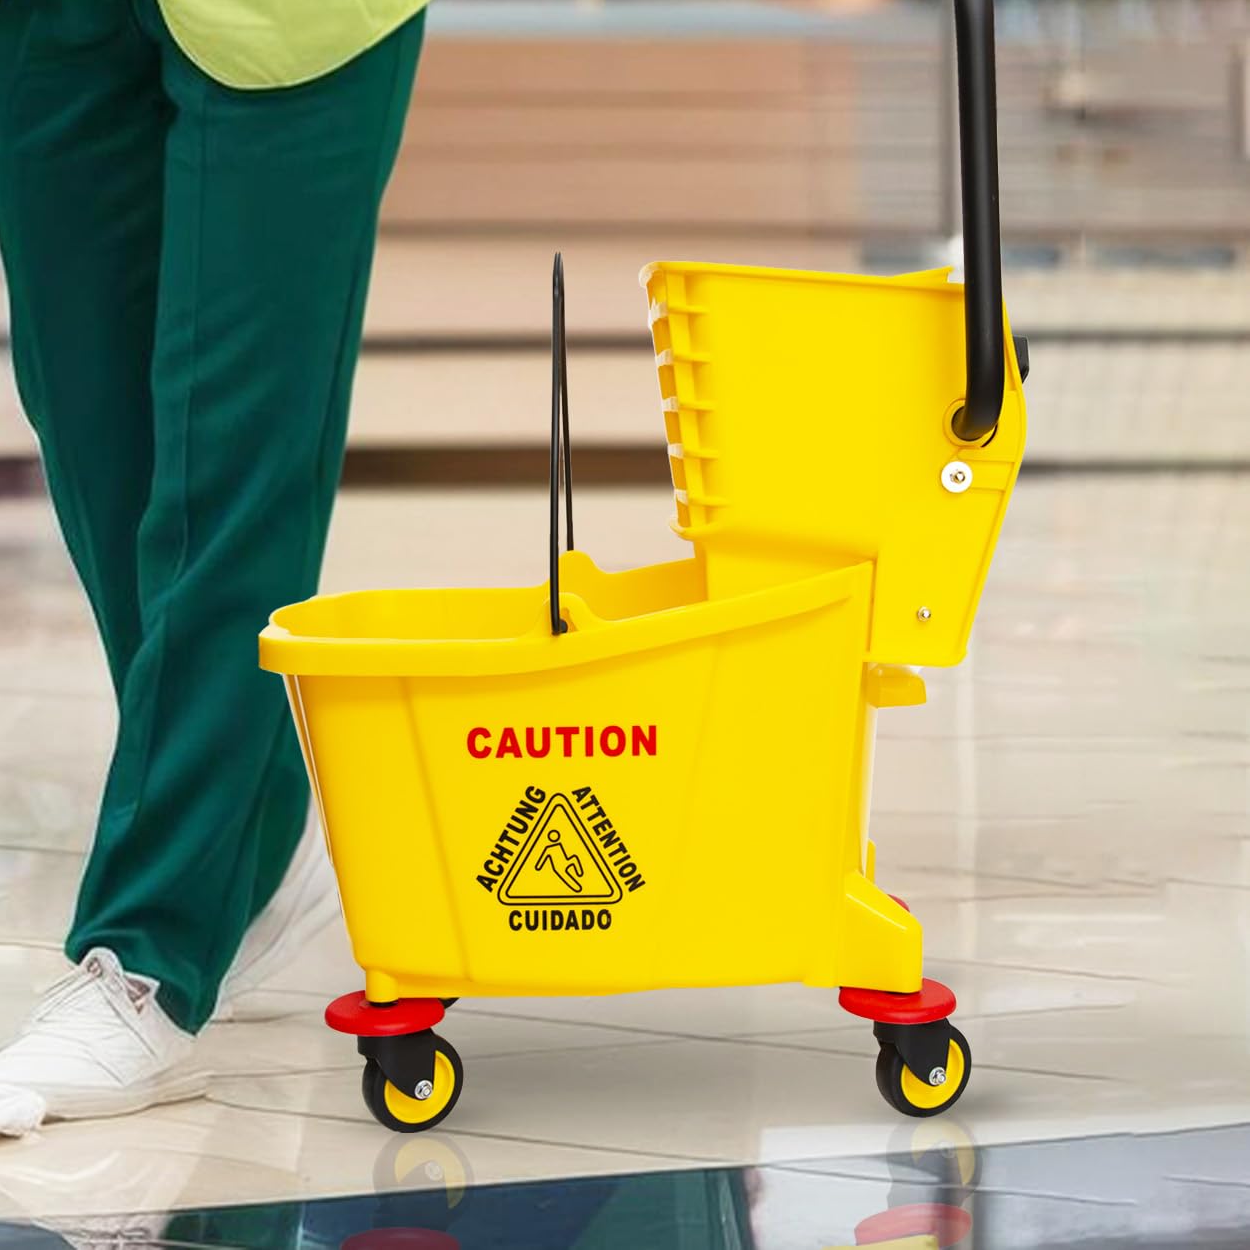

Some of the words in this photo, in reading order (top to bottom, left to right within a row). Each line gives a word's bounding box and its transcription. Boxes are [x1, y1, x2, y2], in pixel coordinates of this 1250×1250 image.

[467, 725, 657, 758] CAUTION
[476, 786, 546, 892] ACHTUNG
[572, 786, 646, 892] ATTENTION
[509, 910, 612, 931] CUIDADO
